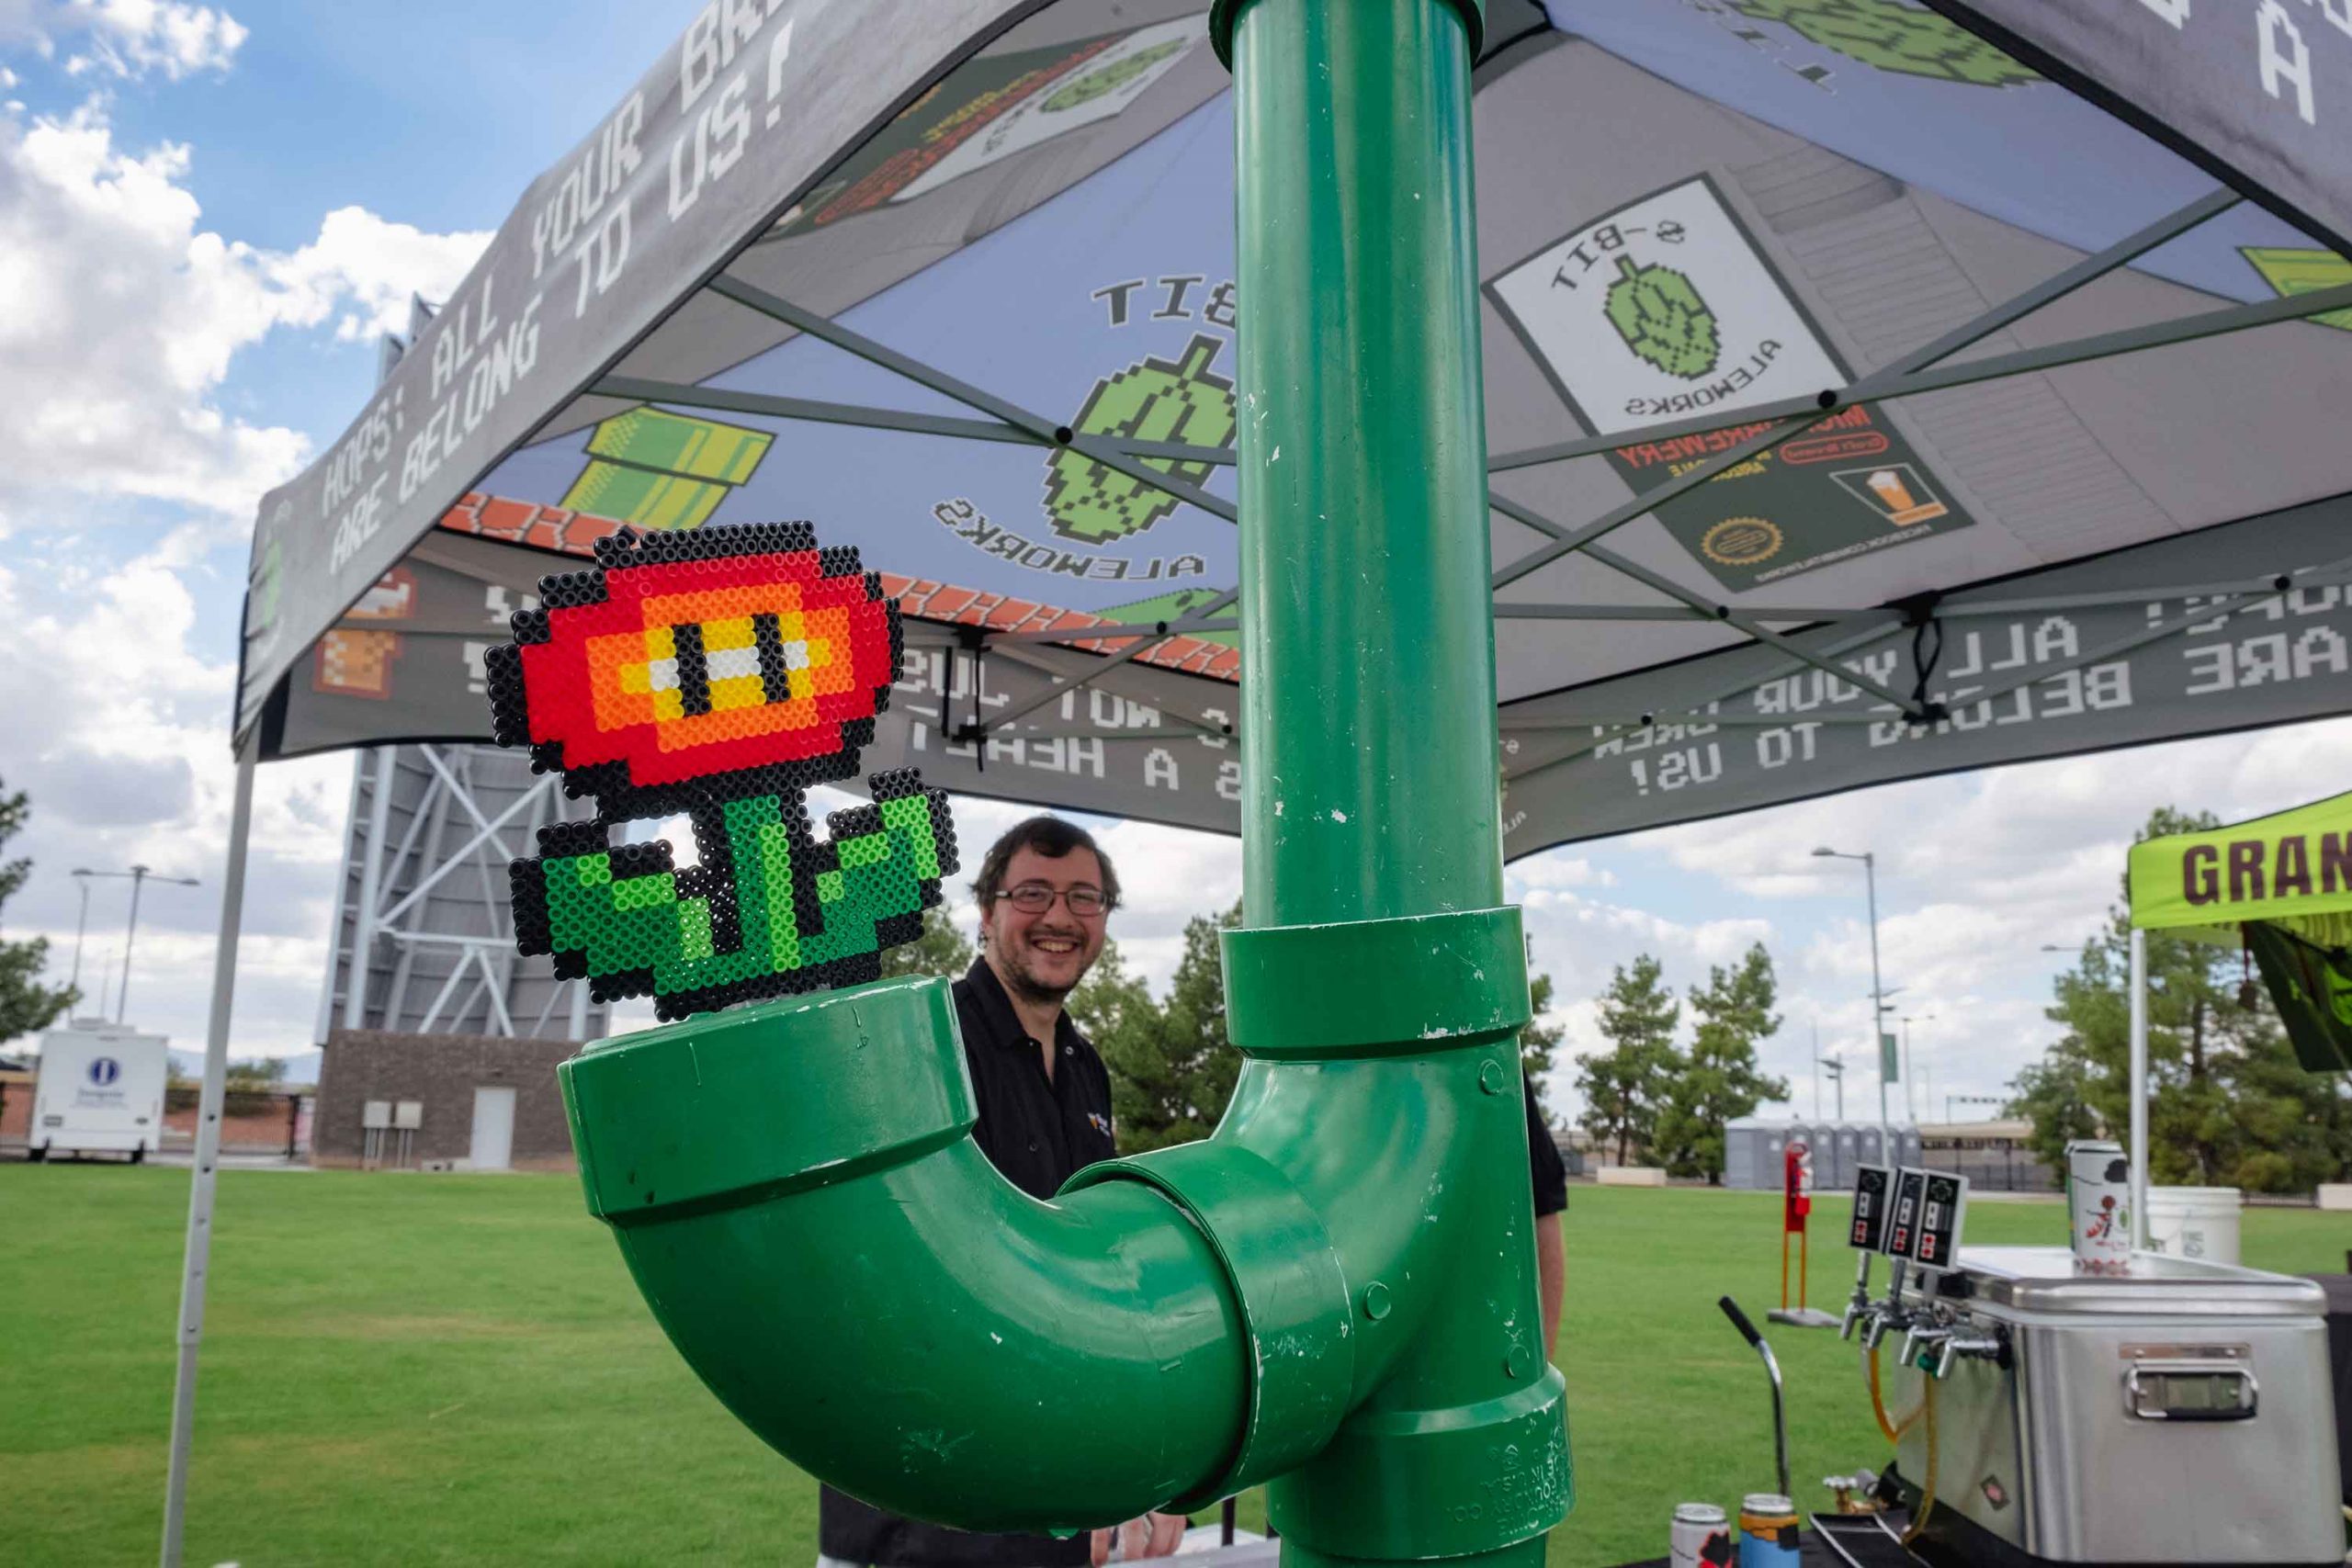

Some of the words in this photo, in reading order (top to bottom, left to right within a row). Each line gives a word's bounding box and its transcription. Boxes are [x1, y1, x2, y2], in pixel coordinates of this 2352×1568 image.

[330, 470, 388, 574] ARE
[399, 292, 542, 504] BELONG
[575, 197, 630, 319] TO
[668, 18, 794, 222] US!
[432, 274, 497, 400] ALL
[532, 91, 643, 279] YOUR
[681, 0, 786, 114] BR
